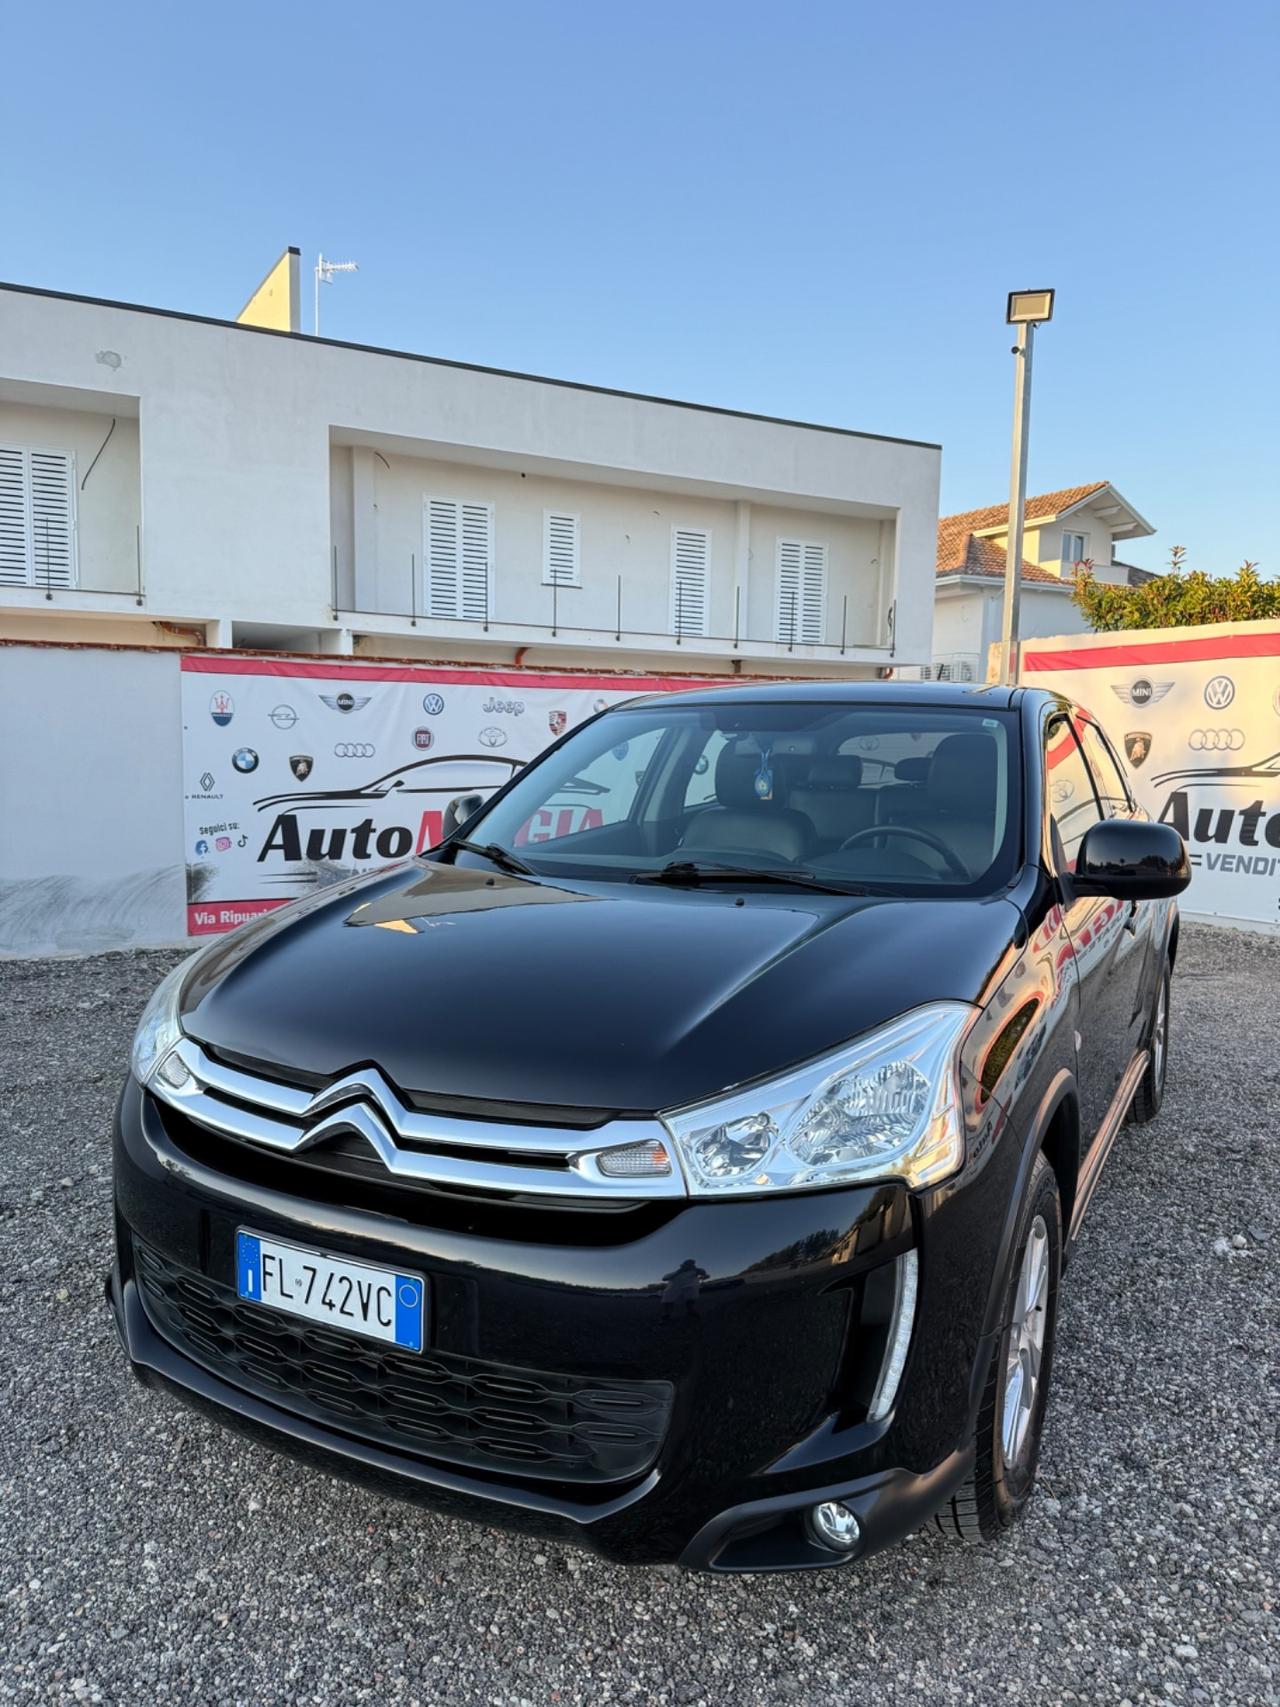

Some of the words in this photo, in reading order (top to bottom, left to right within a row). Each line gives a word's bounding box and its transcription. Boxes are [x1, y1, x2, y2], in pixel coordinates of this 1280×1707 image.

[482, 697, 525, 716] Jeep
[1206, 852, 1280, 877] VENDI
[195, 911, 217, 925] Via
